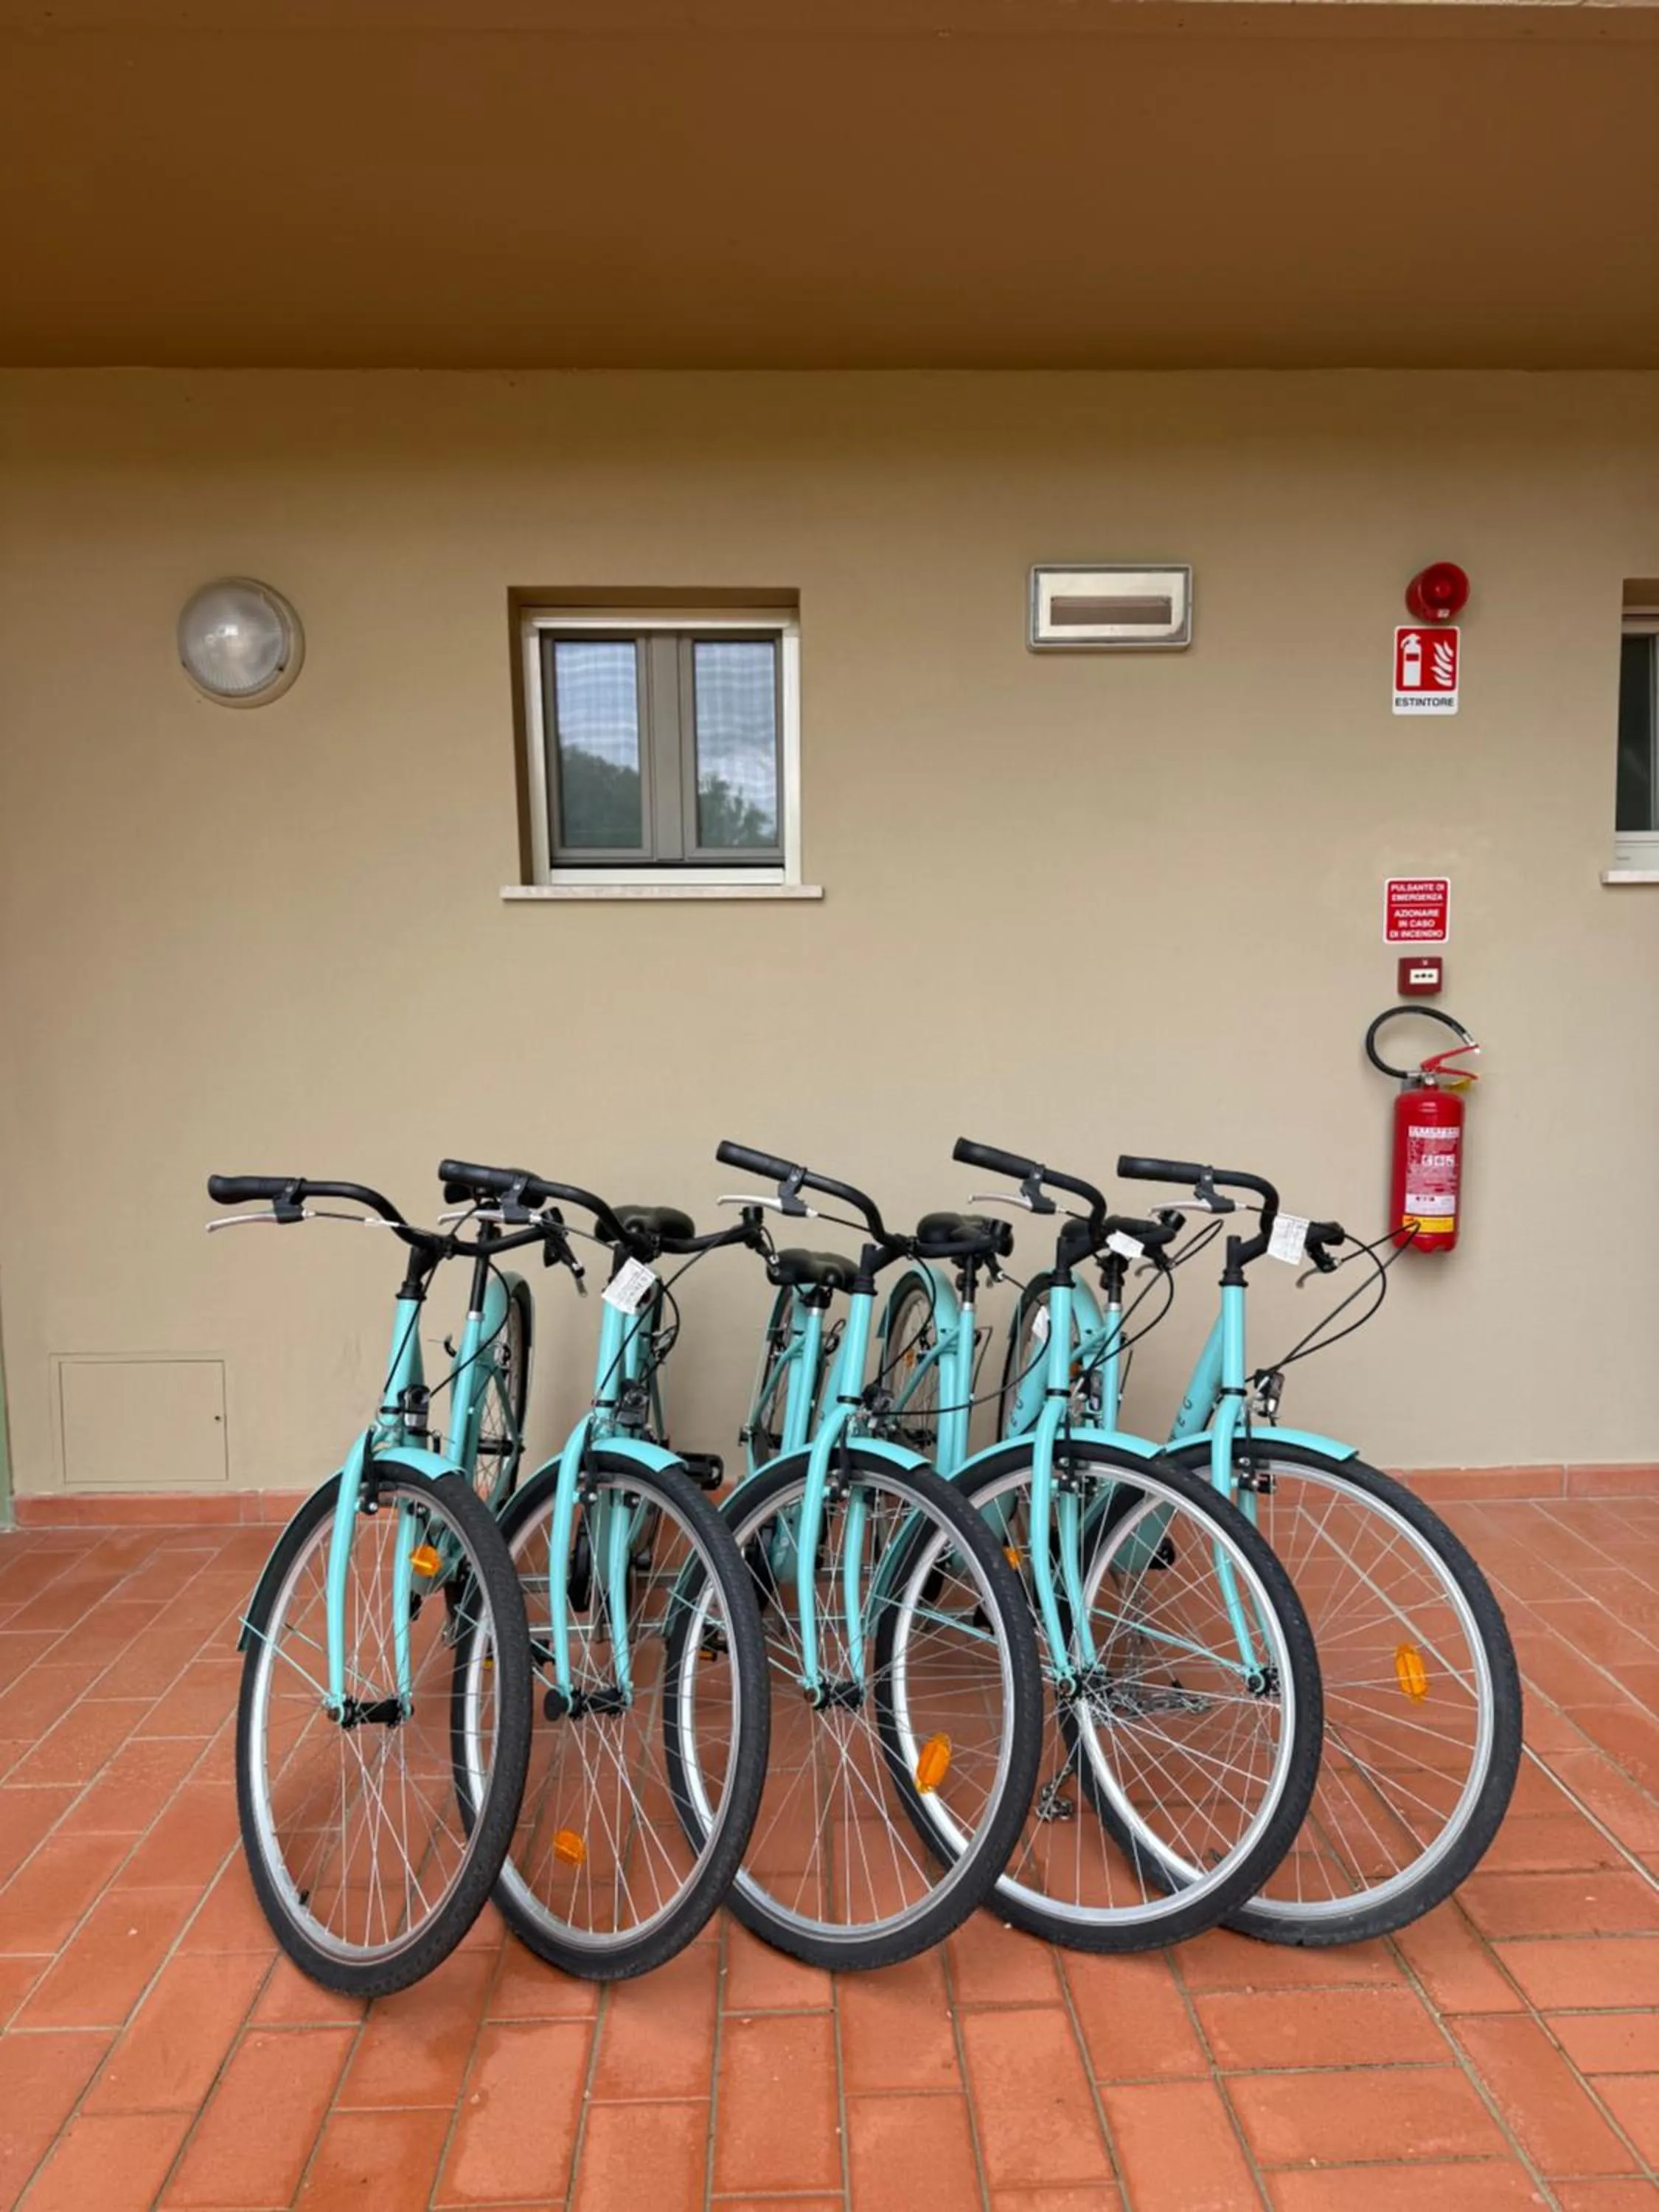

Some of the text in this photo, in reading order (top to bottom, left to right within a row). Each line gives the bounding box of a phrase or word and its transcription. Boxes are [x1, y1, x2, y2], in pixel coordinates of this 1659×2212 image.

[1395, 697, 1454, 707] ESTINTORE
[1391, 883, 1434, 891] PULSANTE
[1394, 909, 1439, 917] AZIONARE
[1409, 919, 1435, 928] CASO
[1401, 930, 1444, 939] INCENDIO
